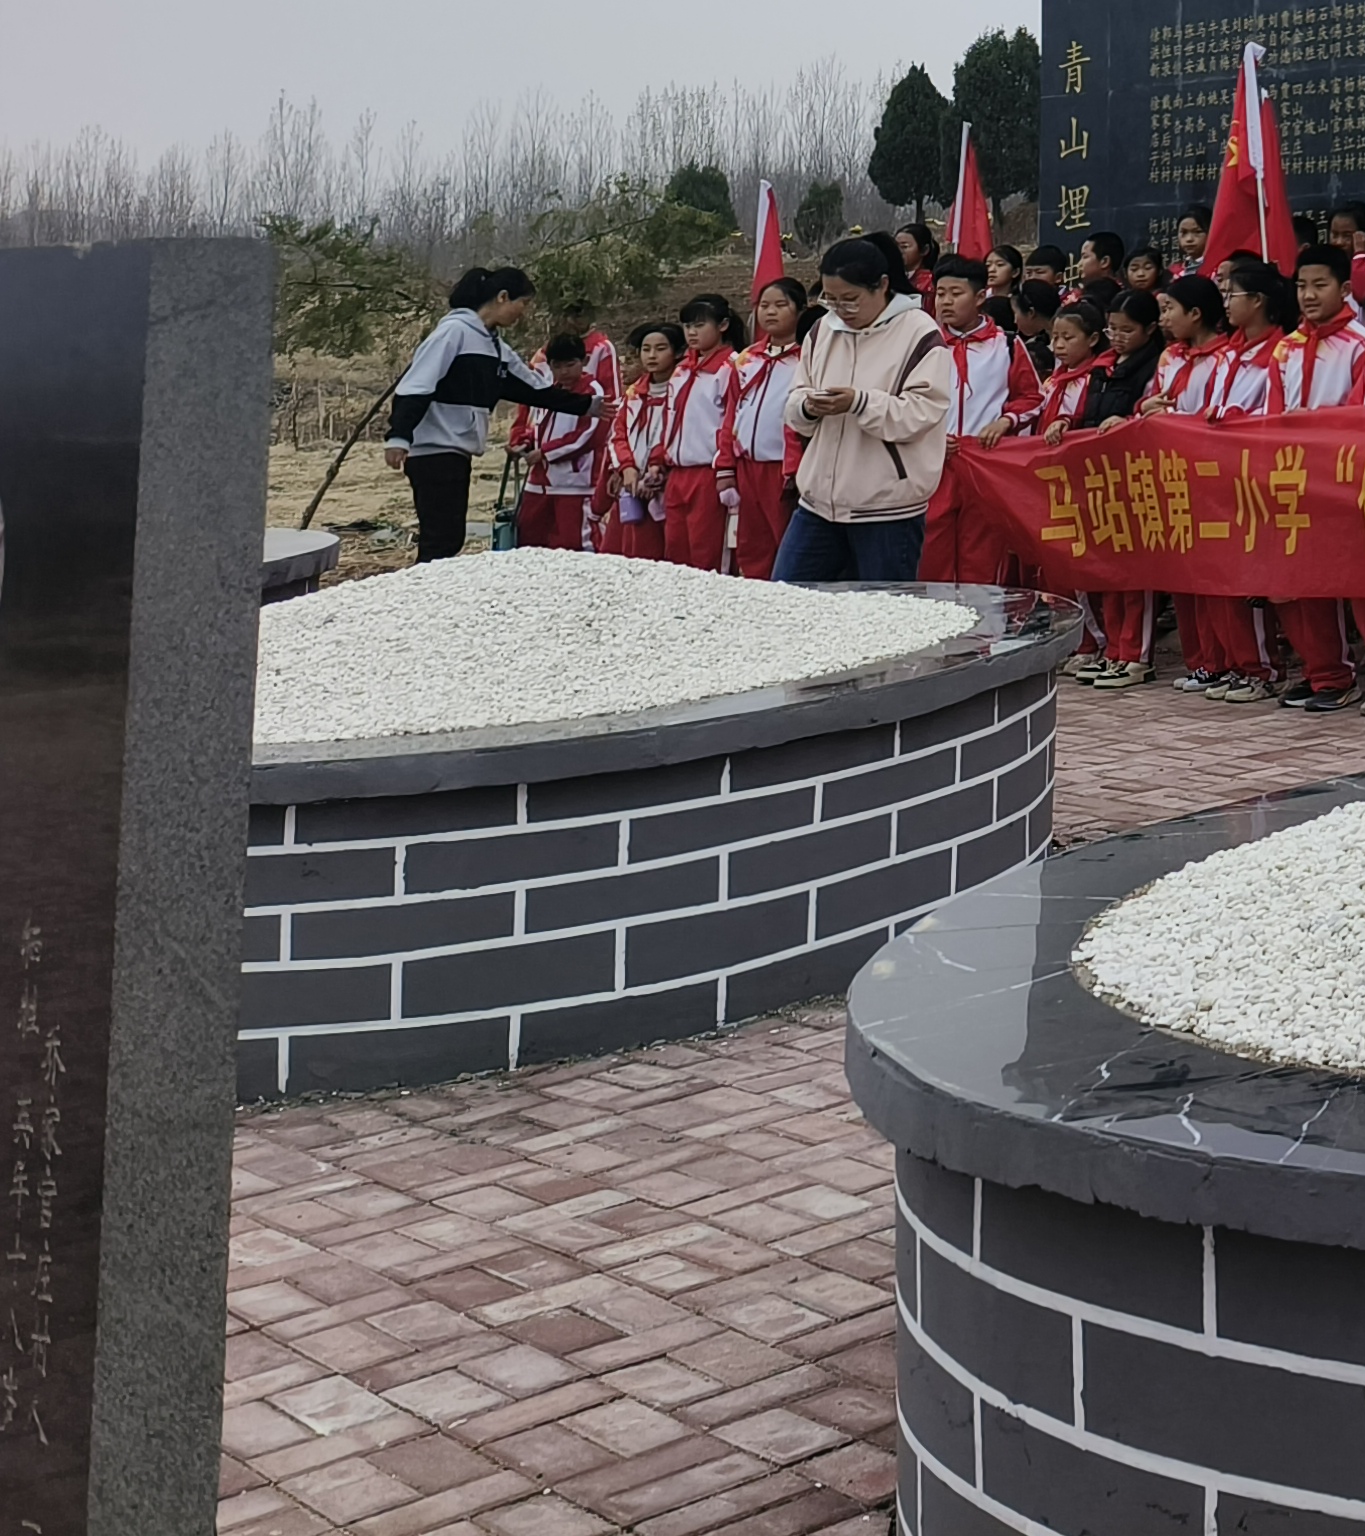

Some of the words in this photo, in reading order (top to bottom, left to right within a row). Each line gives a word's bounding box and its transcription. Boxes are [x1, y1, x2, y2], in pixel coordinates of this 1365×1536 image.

[1034, 445, 1311, 557] 马站镇第二小学
